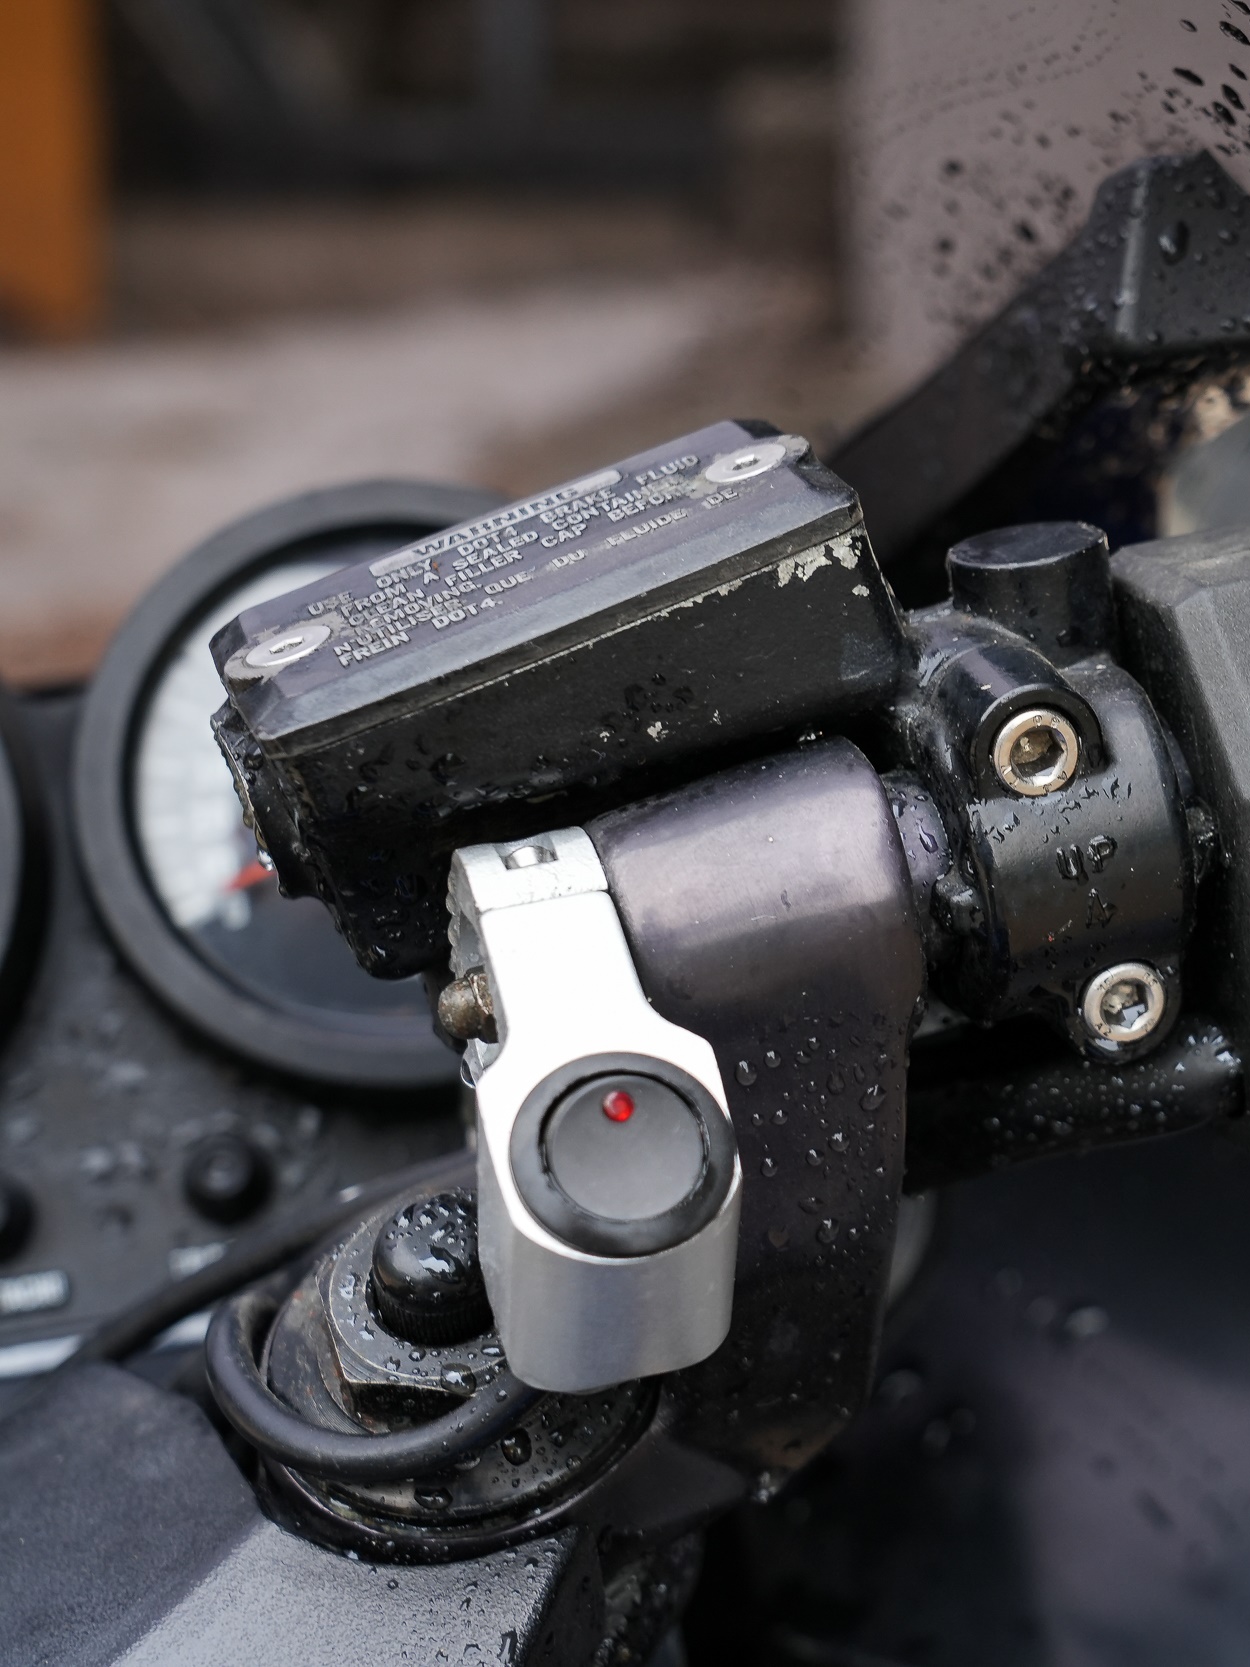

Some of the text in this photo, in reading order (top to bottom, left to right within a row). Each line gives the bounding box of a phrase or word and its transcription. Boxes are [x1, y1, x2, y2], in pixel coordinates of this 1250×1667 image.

[306, 453, 700, 616] USE ONLY DOT4 BRAKE FLUID
[413, 487, 578, 556] WARNING
[484, 570, 532, 596] QUE
[551, 548, 587, 569] DU
[606, 508, 689, 546] FLUIDE
[705, 486, 739, 507] DE
[339, 581, 408, 618] FROM
[424, 570, 441, 585] A
[451, 529, 540, 571] SEALED
[347, 588, 426, 627] CLEAN
[444, 548, 524, 587] FILLER
[540, 522, 589, 549] CAP
[338, 630, 411, 667] FREIN
[1056, 835, 1117, 880] UP
